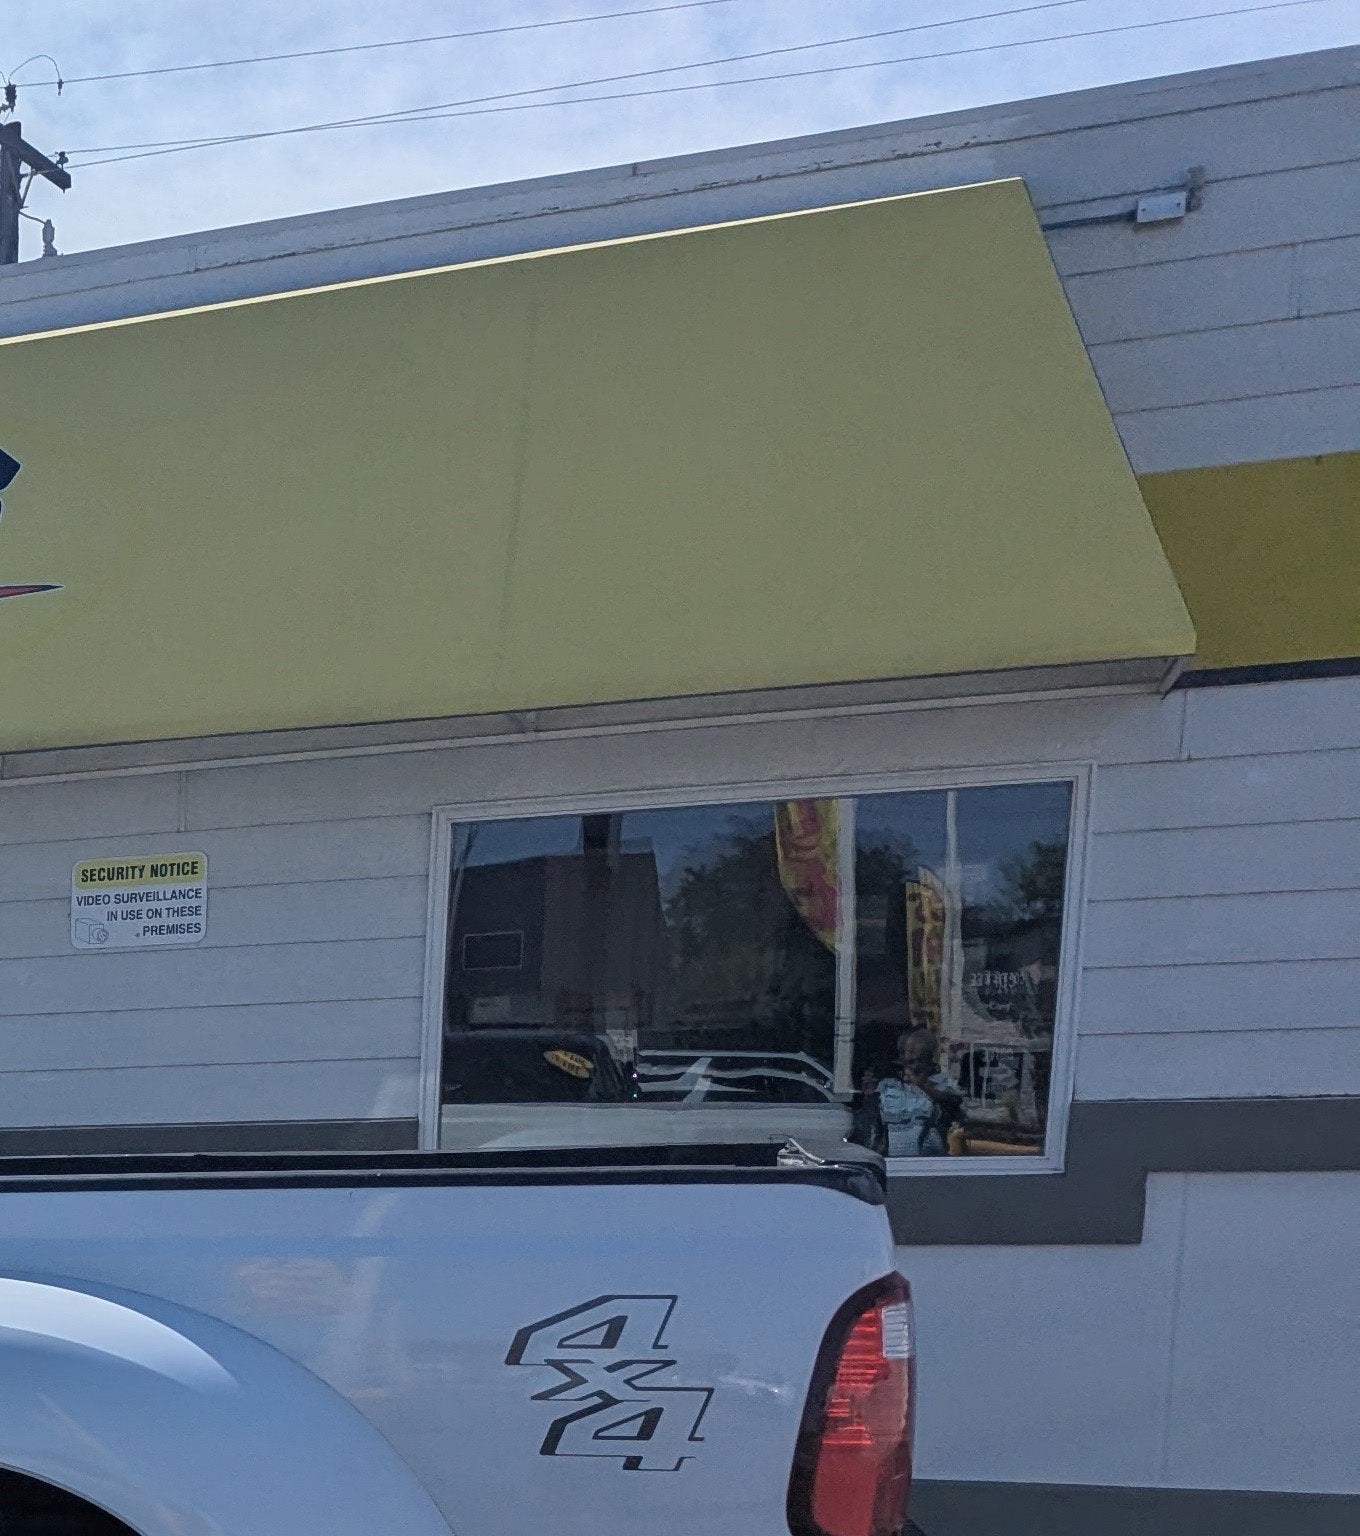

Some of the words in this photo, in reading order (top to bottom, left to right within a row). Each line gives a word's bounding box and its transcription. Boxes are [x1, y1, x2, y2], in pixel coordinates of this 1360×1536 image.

[81, 864, 146, 883] SECURITY
[150, 861, 199, 878] NOTICE
[76, 893, 111, 907] VIDEO
[114, 888, 202, 904] SURVEILLANCE
[106, 910, 119, 922] IN
[120, 908, 143, 921] USE
[146, 907, 162, 920] ON
[165, 905, 202, 919] THESE
[142, 922, 202, 937] PREMISES
